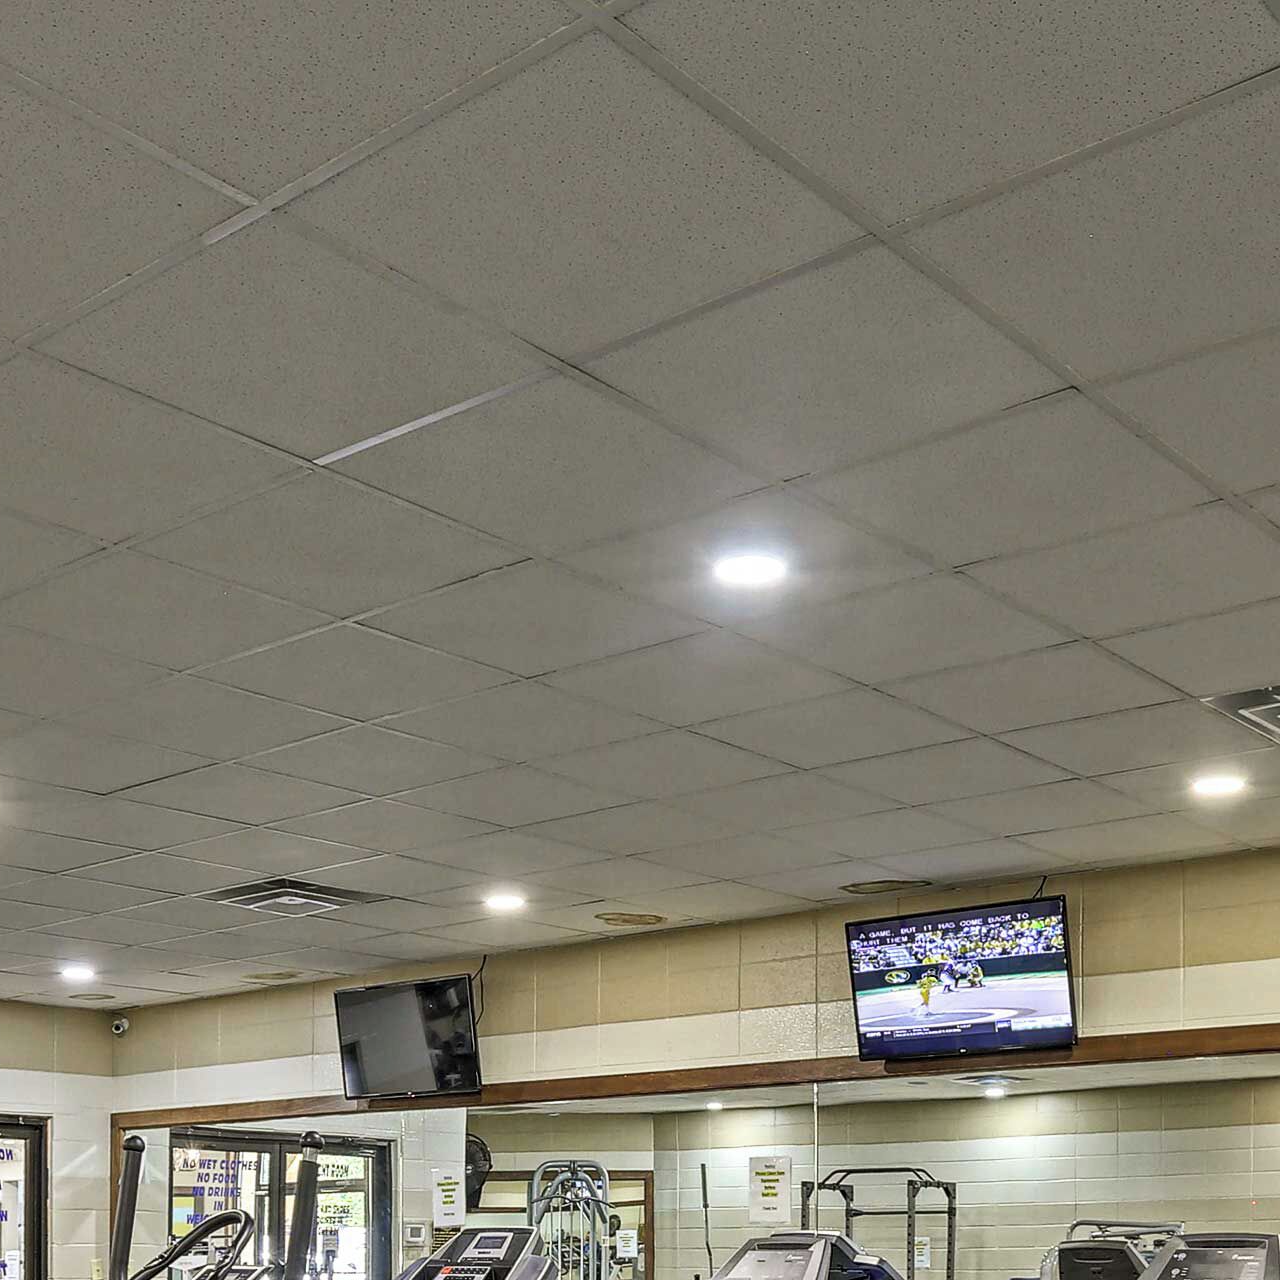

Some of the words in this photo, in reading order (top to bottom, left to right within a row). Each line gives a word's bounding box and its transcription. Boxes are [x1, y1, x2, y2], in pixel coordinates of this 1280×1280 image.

[900, 926, 917, 935] BUT
[938, 922, 956, 930] HAS
[960, 918, 983, 927] COME
[988, 915, 1012, 924] BACK
[1016, 912, 1030, 920] TO
[182, 1159, 196, 1169] NO
[199, 1159, 217, 1170] WET
[220, 1160, 258, 1171] CLOTHES
[197, 1173, 210, 1183] NO
[212, 1173, 236, 1184] FOOD
[192, 1186, 205, 1197] NO
[208, 1187, 240, 1197] DRINKS
[213, 1201, 224, 1211] IN
